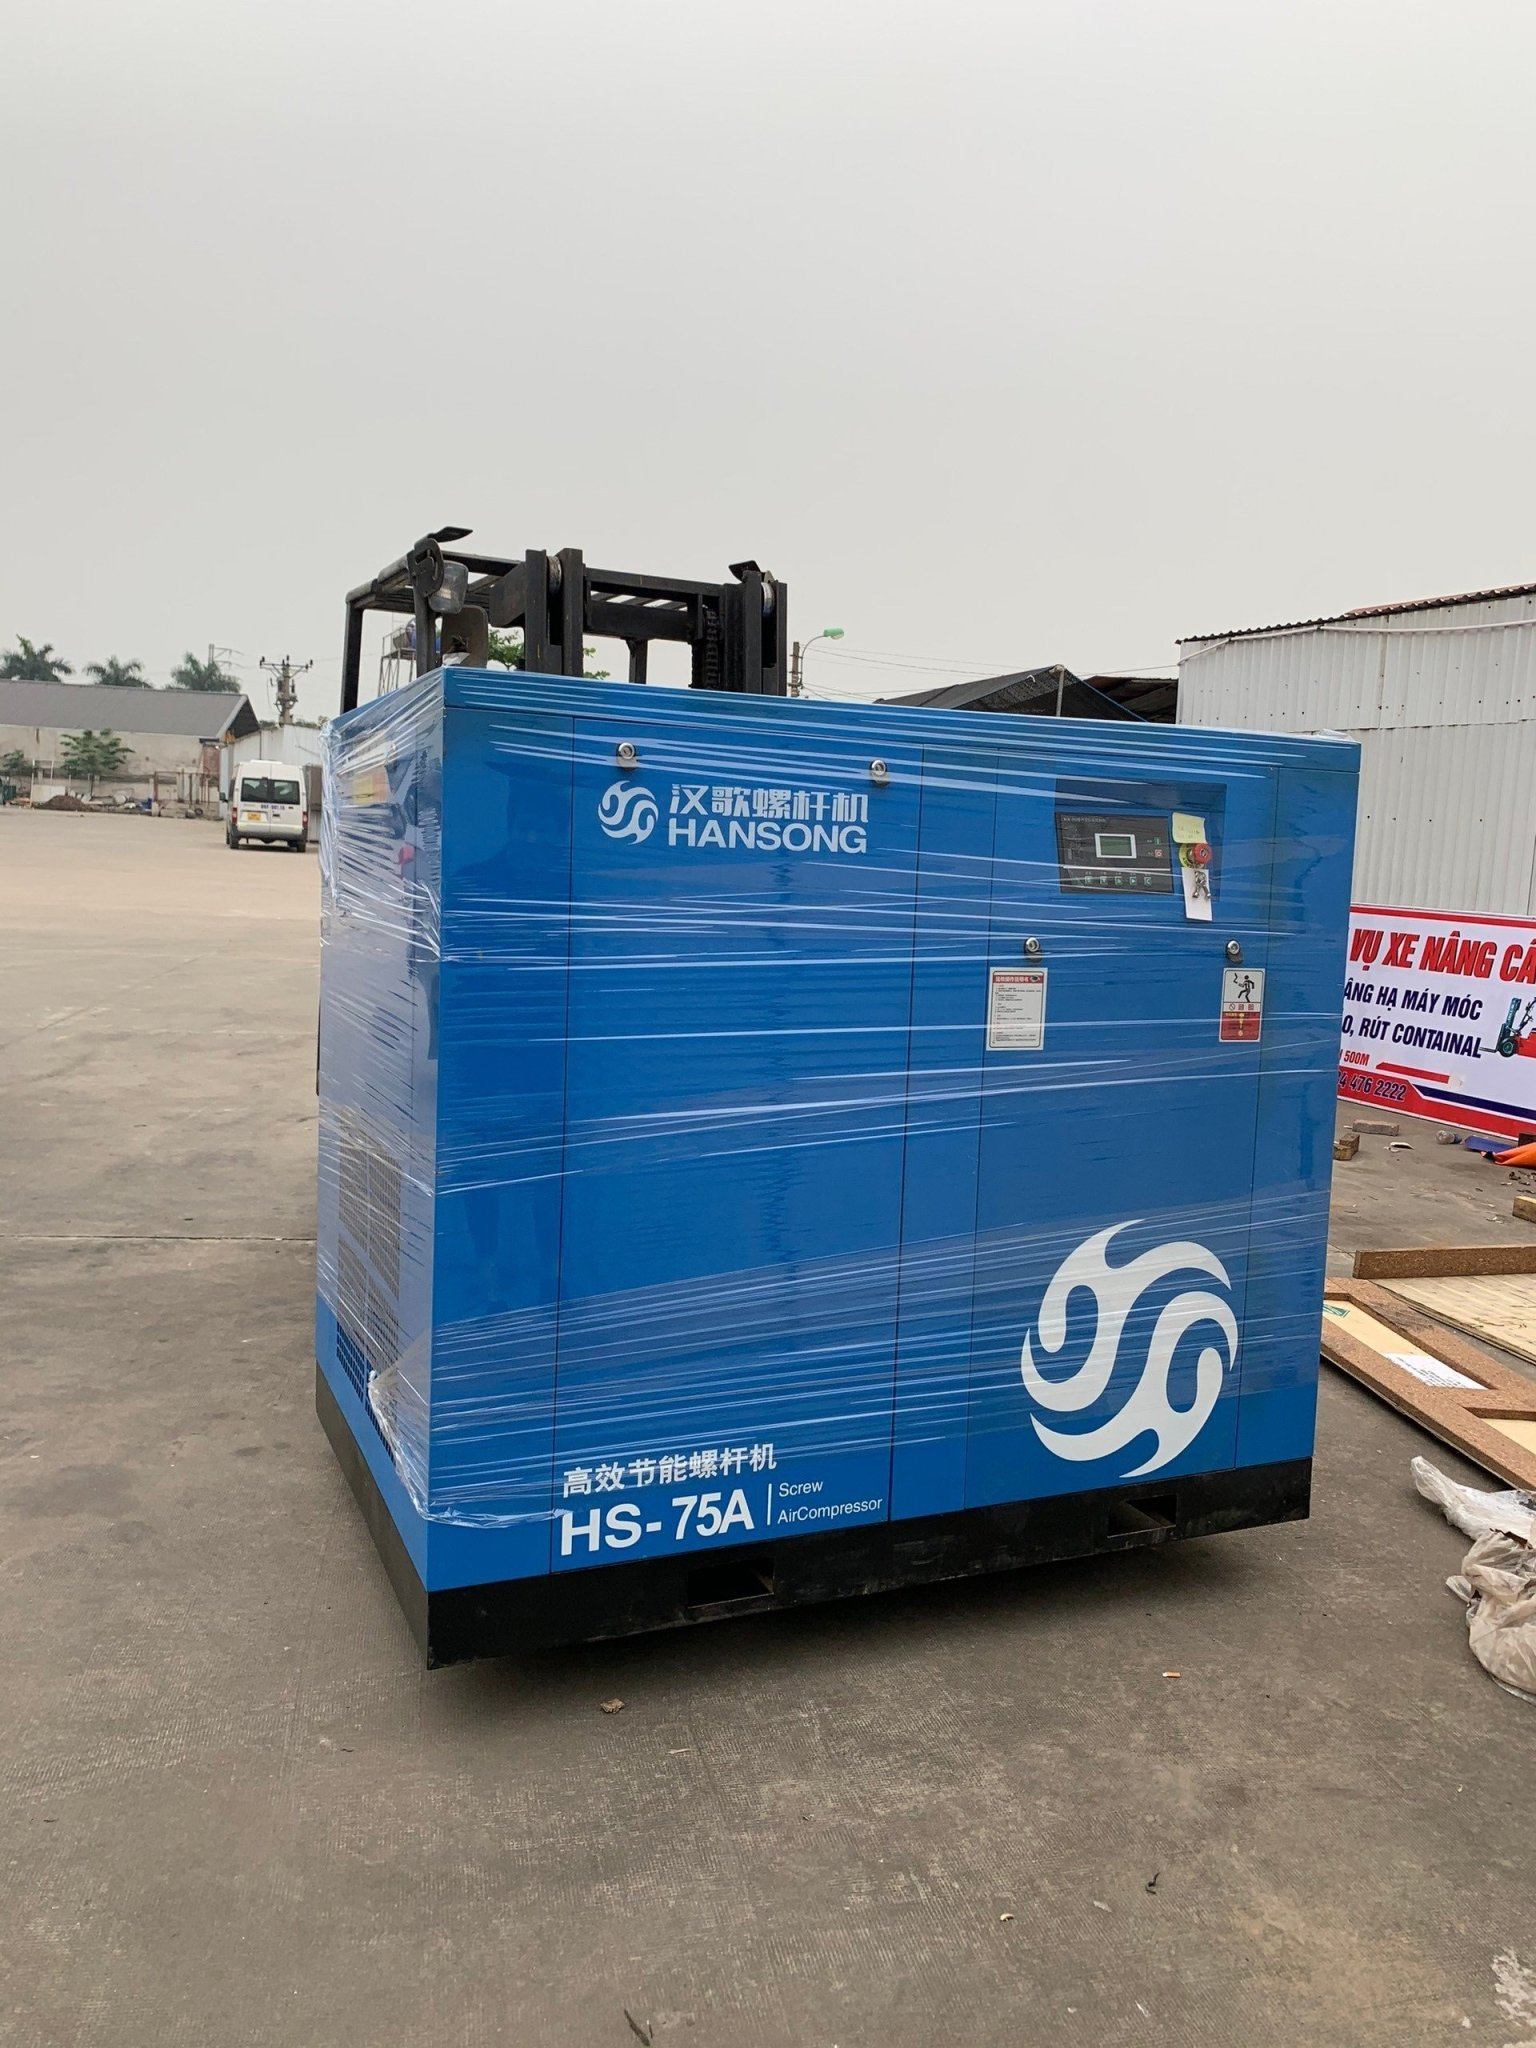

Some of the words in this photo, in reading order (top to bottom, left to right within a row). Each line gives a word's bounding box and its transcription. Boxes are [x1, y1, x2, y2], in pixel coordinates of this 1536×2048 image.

[669, 783, 869, 823] 汉歌螺杆机
[668, 817, 867, 854] HANSONG
[1350, 928, 1384, 971] VỤ
[1382, 931, 1420, 968] XE
[1419, 930, 1497, 979] NÂNG
[1375, 985, 1398, 1011] HẠ
[1401, 988, 1442, 1015] MÁY
[1441, 994, 1483, 1021] MÓC
[1358, 1015, 1390, 1041] RÚT
[1391, 1023, 1482, 1059] CONTAINAL
[1343, 1050, 1370, 1066] 500M
[1350, 1074, 1373, 1094] 476
[1374, 1079, 1407, 1101] 2222
[562, 1443, 777, 1498] 高效节能螺杆机
[778, 1479, 824, 1498] Screw
[777, 1495, 883, 1525] AirCompressor
